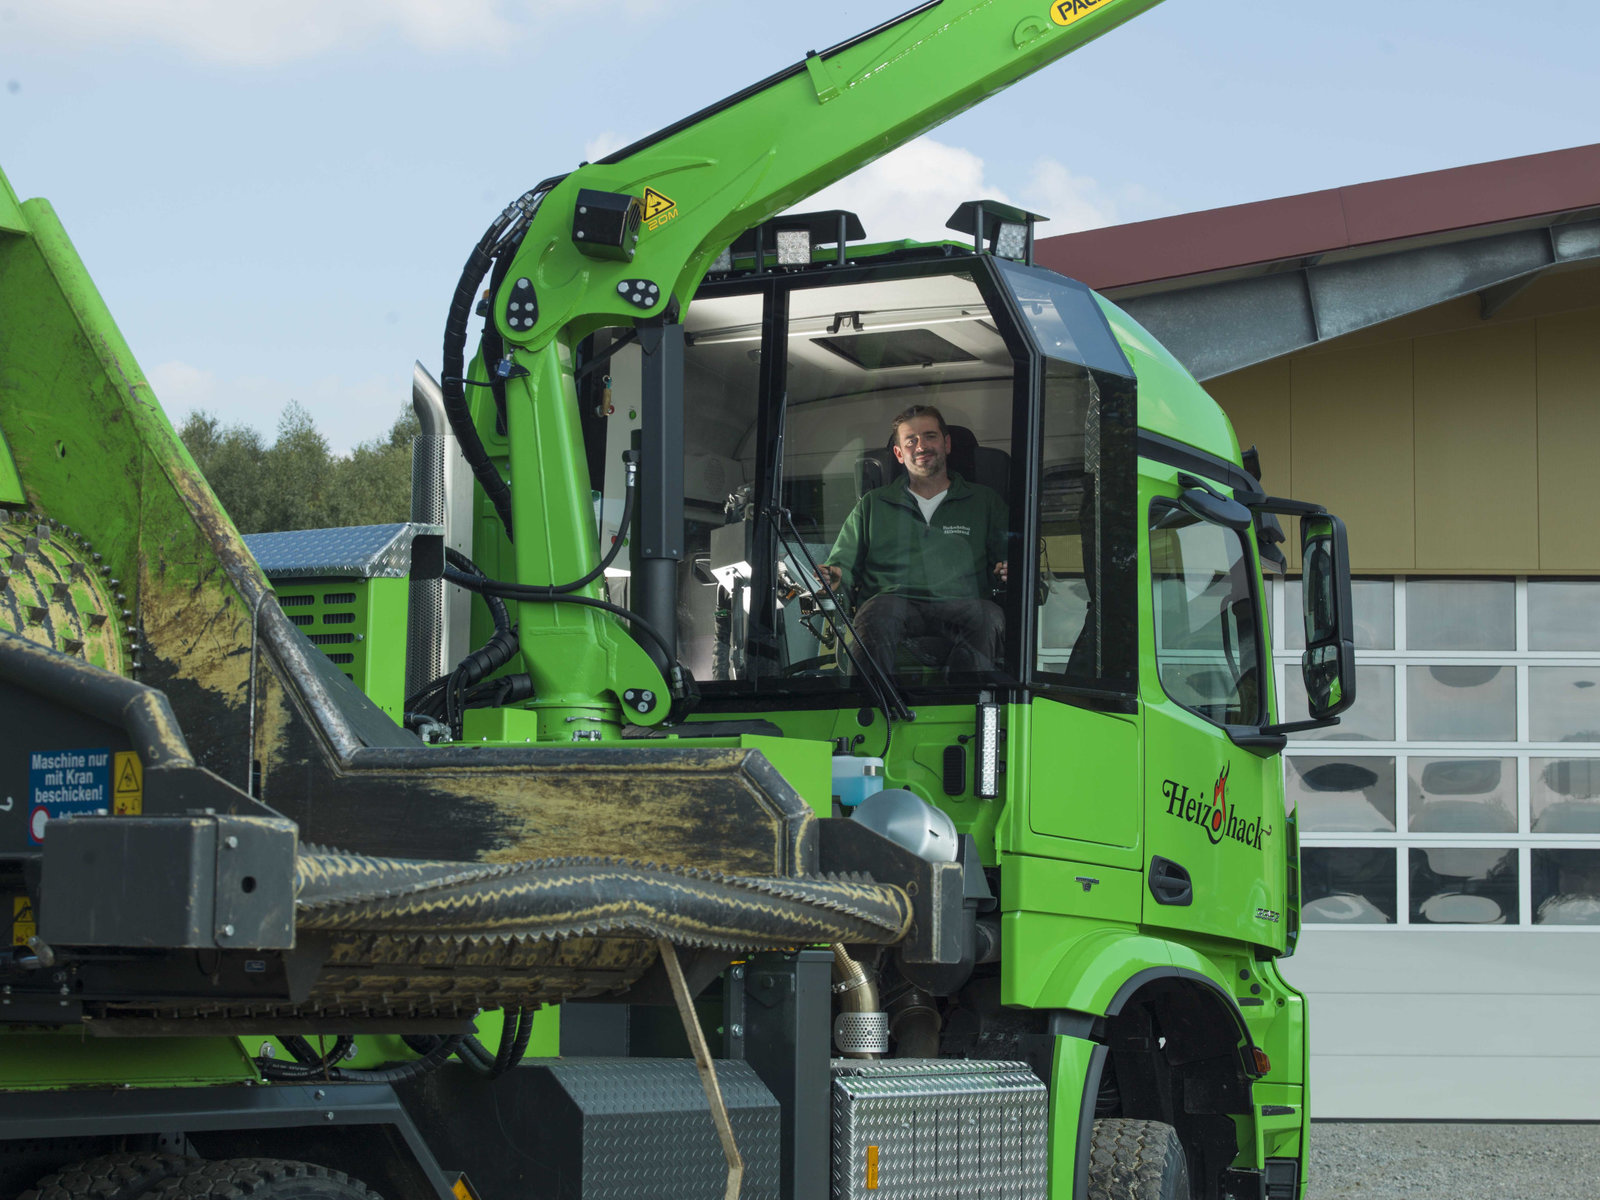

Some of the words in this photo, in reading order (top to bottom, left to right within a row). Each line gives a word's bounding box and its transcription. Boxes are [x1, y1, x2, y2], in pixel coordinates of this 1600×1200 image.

[32, 752, 86, 770] Maschine
[88, 753, 109, 767] nur
[45, 770, 64, 786] mit
[66, 768, 94, 785] Kran
[35, 784, 103, 803] beschicken!
